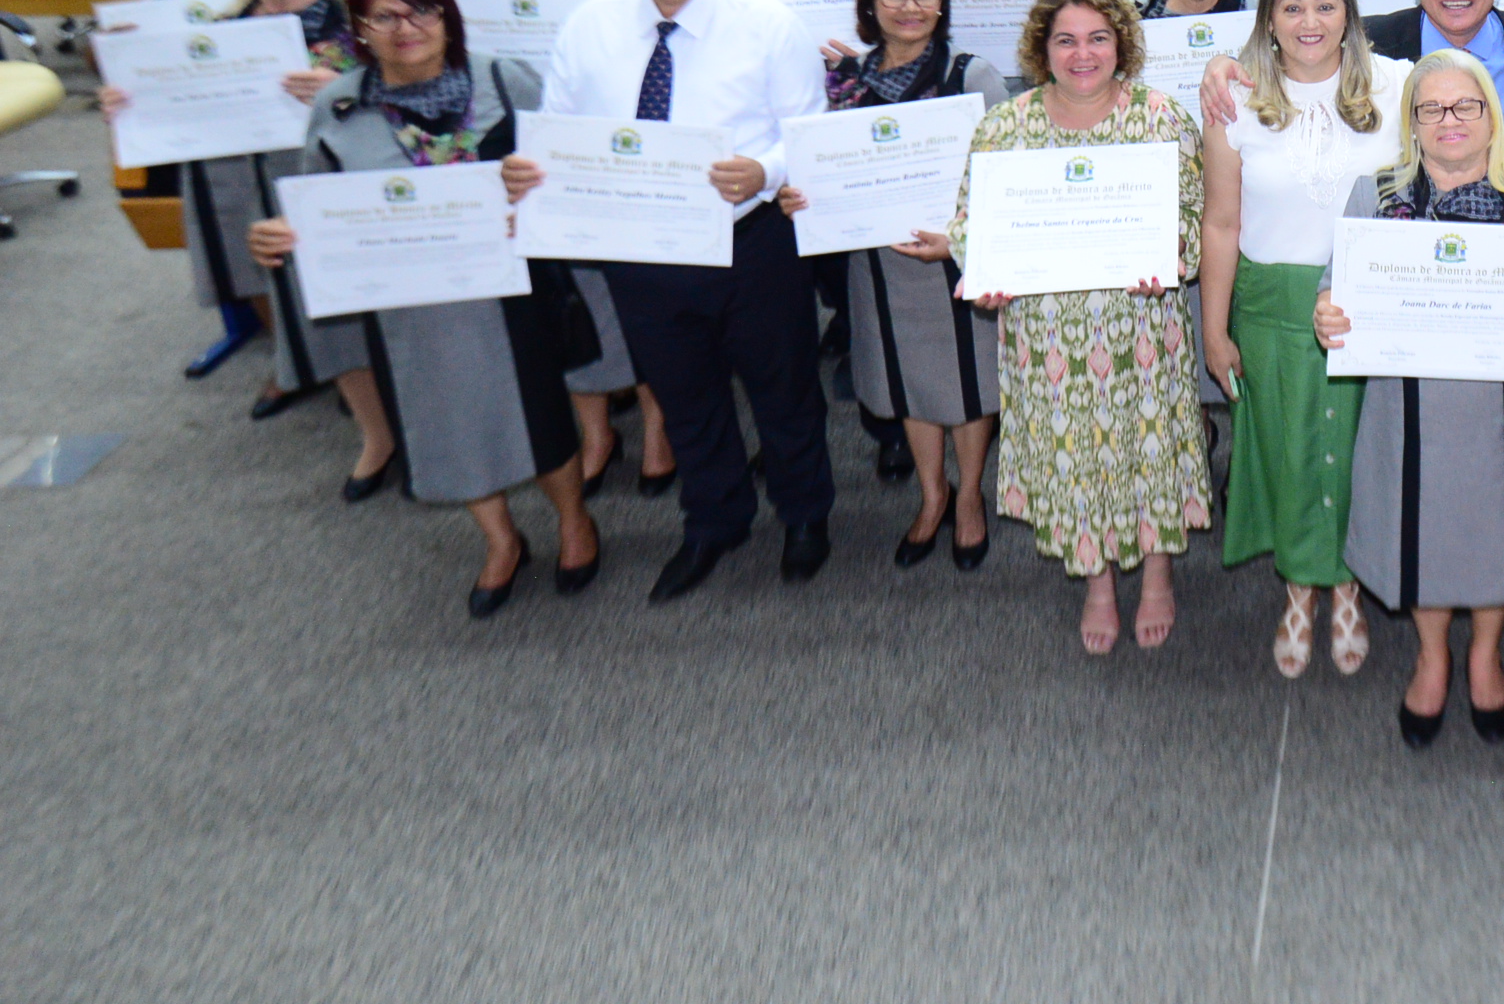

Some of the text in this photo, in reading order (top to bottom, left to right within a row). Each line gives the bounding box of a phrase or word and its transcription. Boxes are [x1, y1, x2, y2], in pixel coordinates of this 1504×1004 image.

[1004, 182, 1152, 198] Diploma de Honra ao Mérito
[1043, 219, 1069, 228] Santos
[1071, 218, 1110, 228] Cerqueira
[1368, 262, 1417, 276] Diploma
[1420, 265, 1432, 275] de
[1436, 264, 1472, 277] Honra
[1475, 268, 1488, 277] ao
[1389, 274, 1421, 283] Câmara
[1423, 275, 1462, 285] Municipal
[1465, 277, 1473, 285] de
[1400, 299, 1492, 310] Joana Darc de Farias
